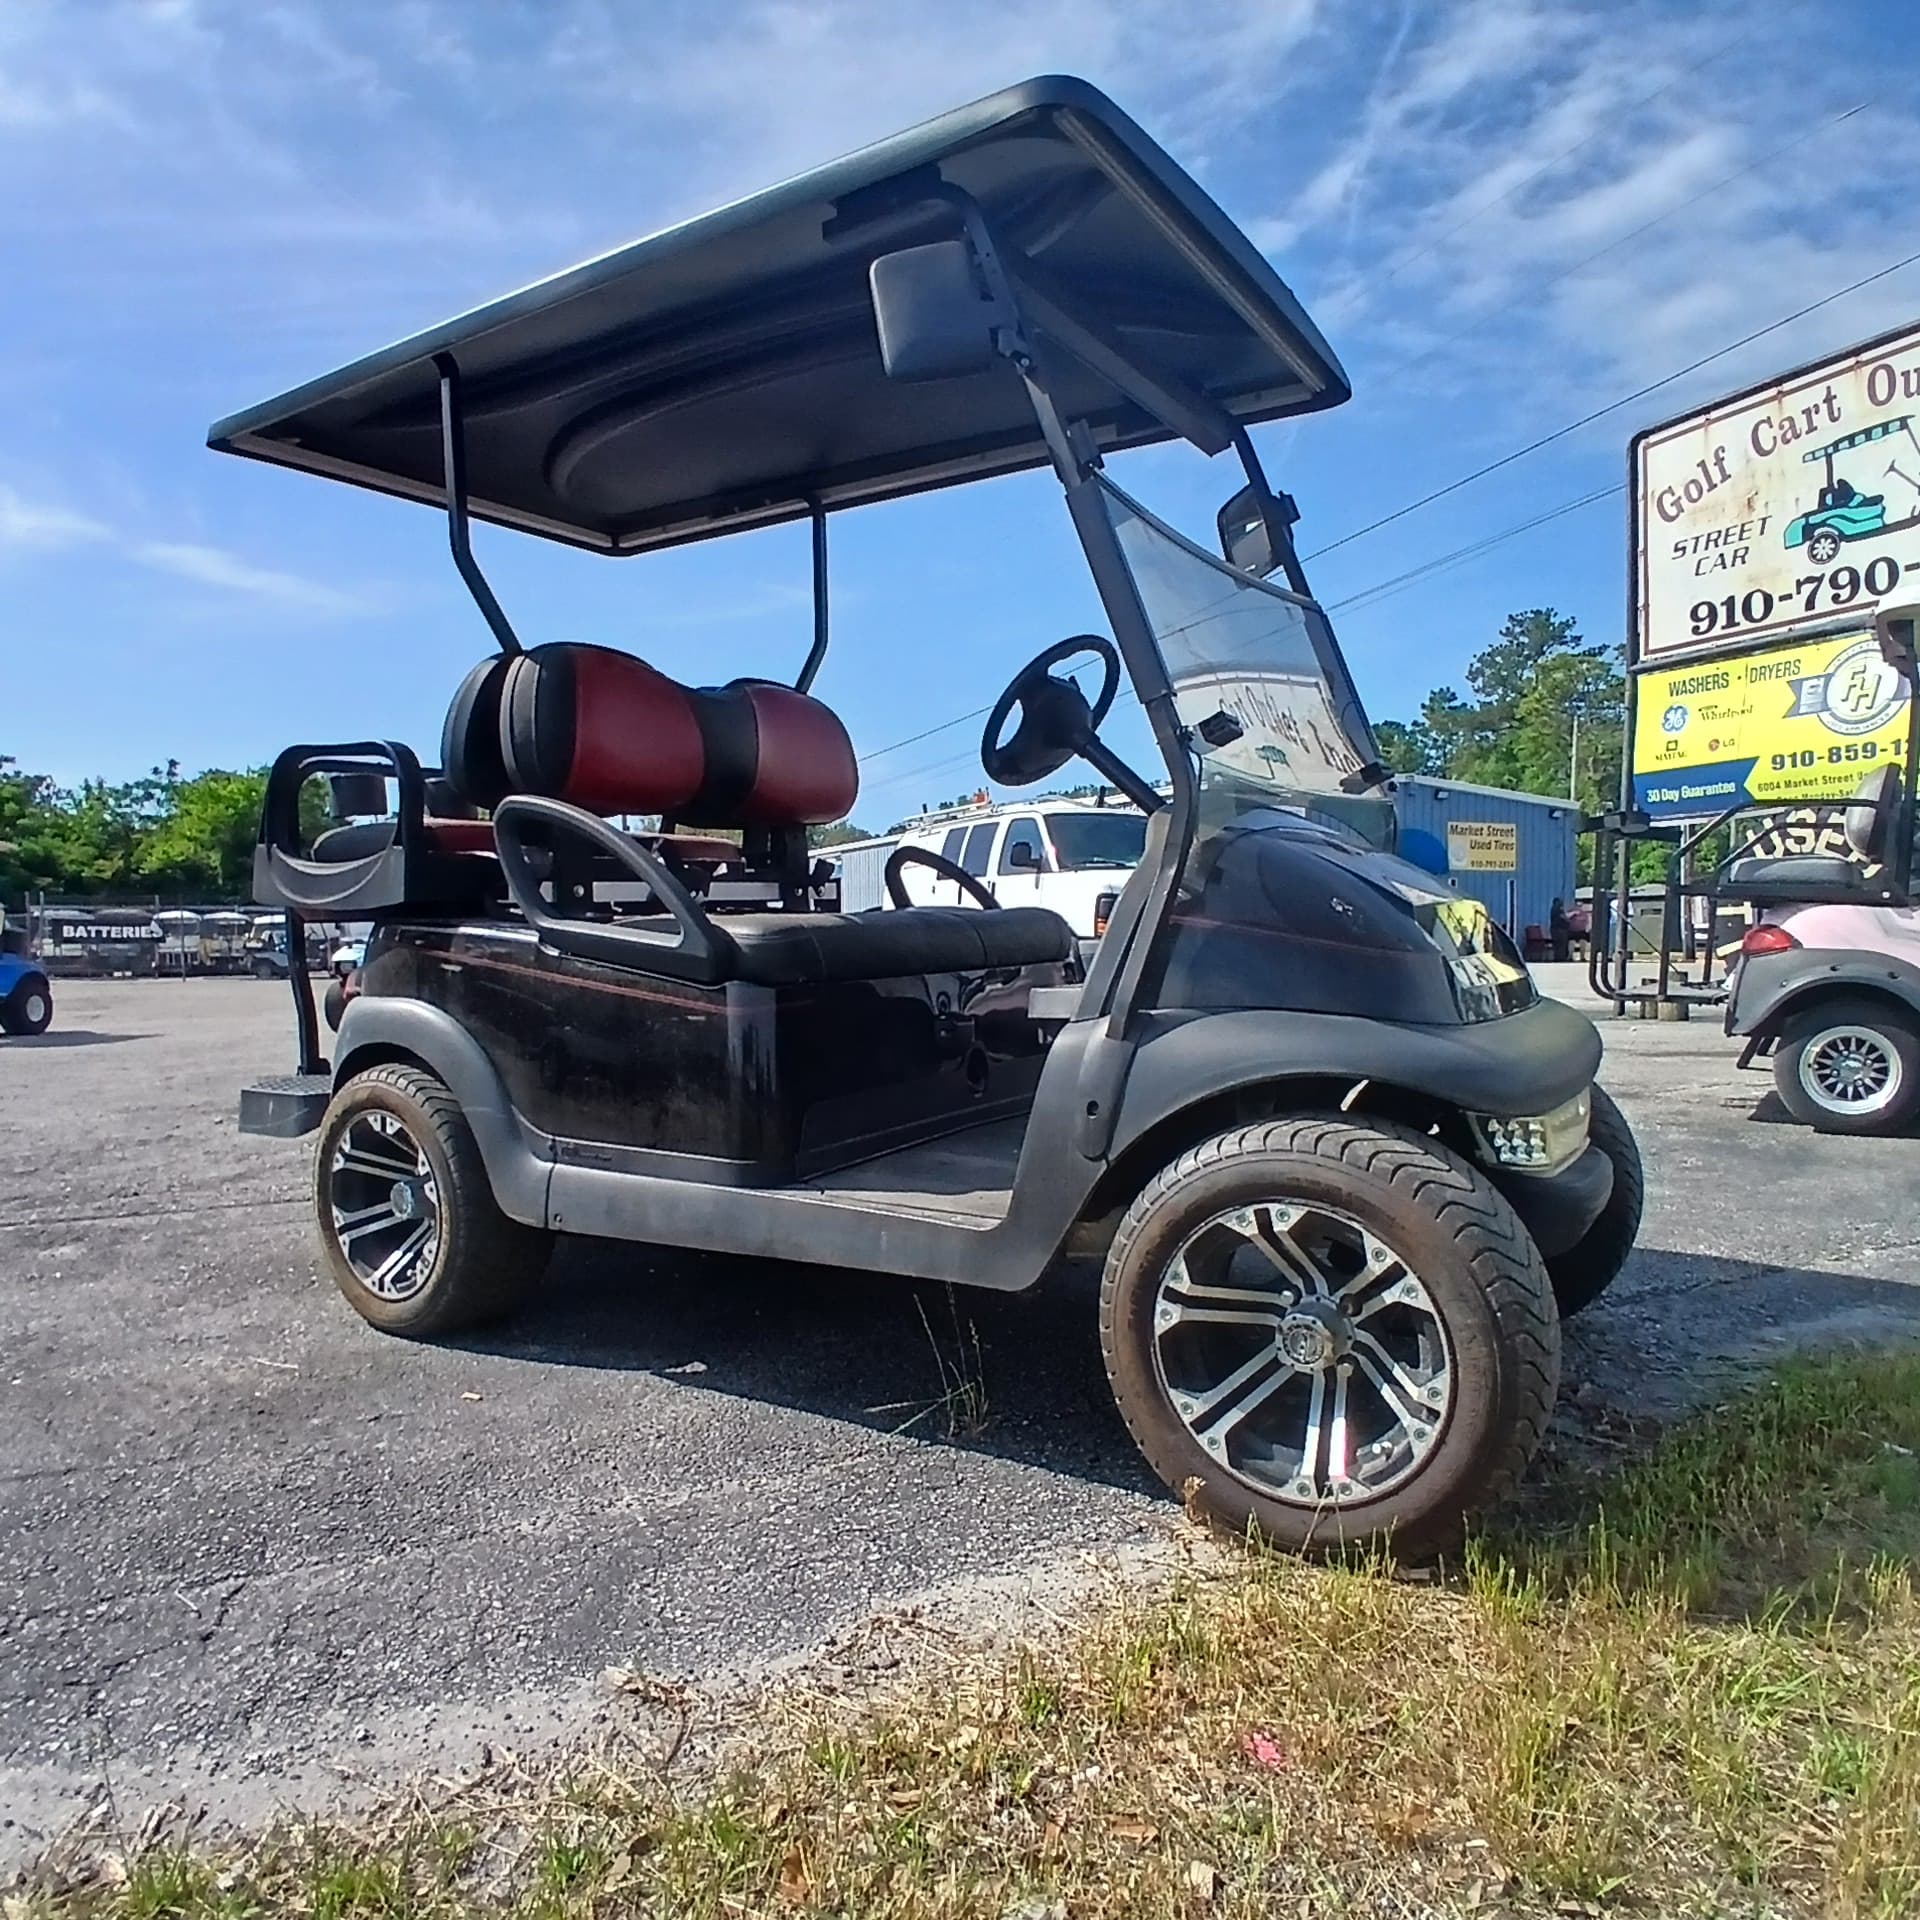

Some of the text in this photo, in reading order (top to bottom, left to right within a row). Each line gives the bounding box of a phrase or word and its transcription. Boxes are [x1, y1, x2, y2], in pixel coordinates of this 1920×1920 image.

[1656, 446, 1732, 523] Golf
[1751, 386, 1841, 458] Cart
[1671, 515, 1772, 560] STREET
[1694, 546, 1750, 576] CAR
[1689, 556, 1920, 636] 910-790-
[1669, 659, 1801, 697] WASHERS DRYERS
[1771, 737, 1909, 771] 910-859-1
[1646, 781, 1736, 803] 30 Day Guarantee
[1757, 781, 1781, 793] 6004
[1784, 777, 1818, 789] Market
[1822, 774, 1854, 785] Street
[1449, 824, 1514, 837] Market Street
[1469, 839, 1515, 851] Used Tires
[62, 925, 163, 938] BATTERIES
